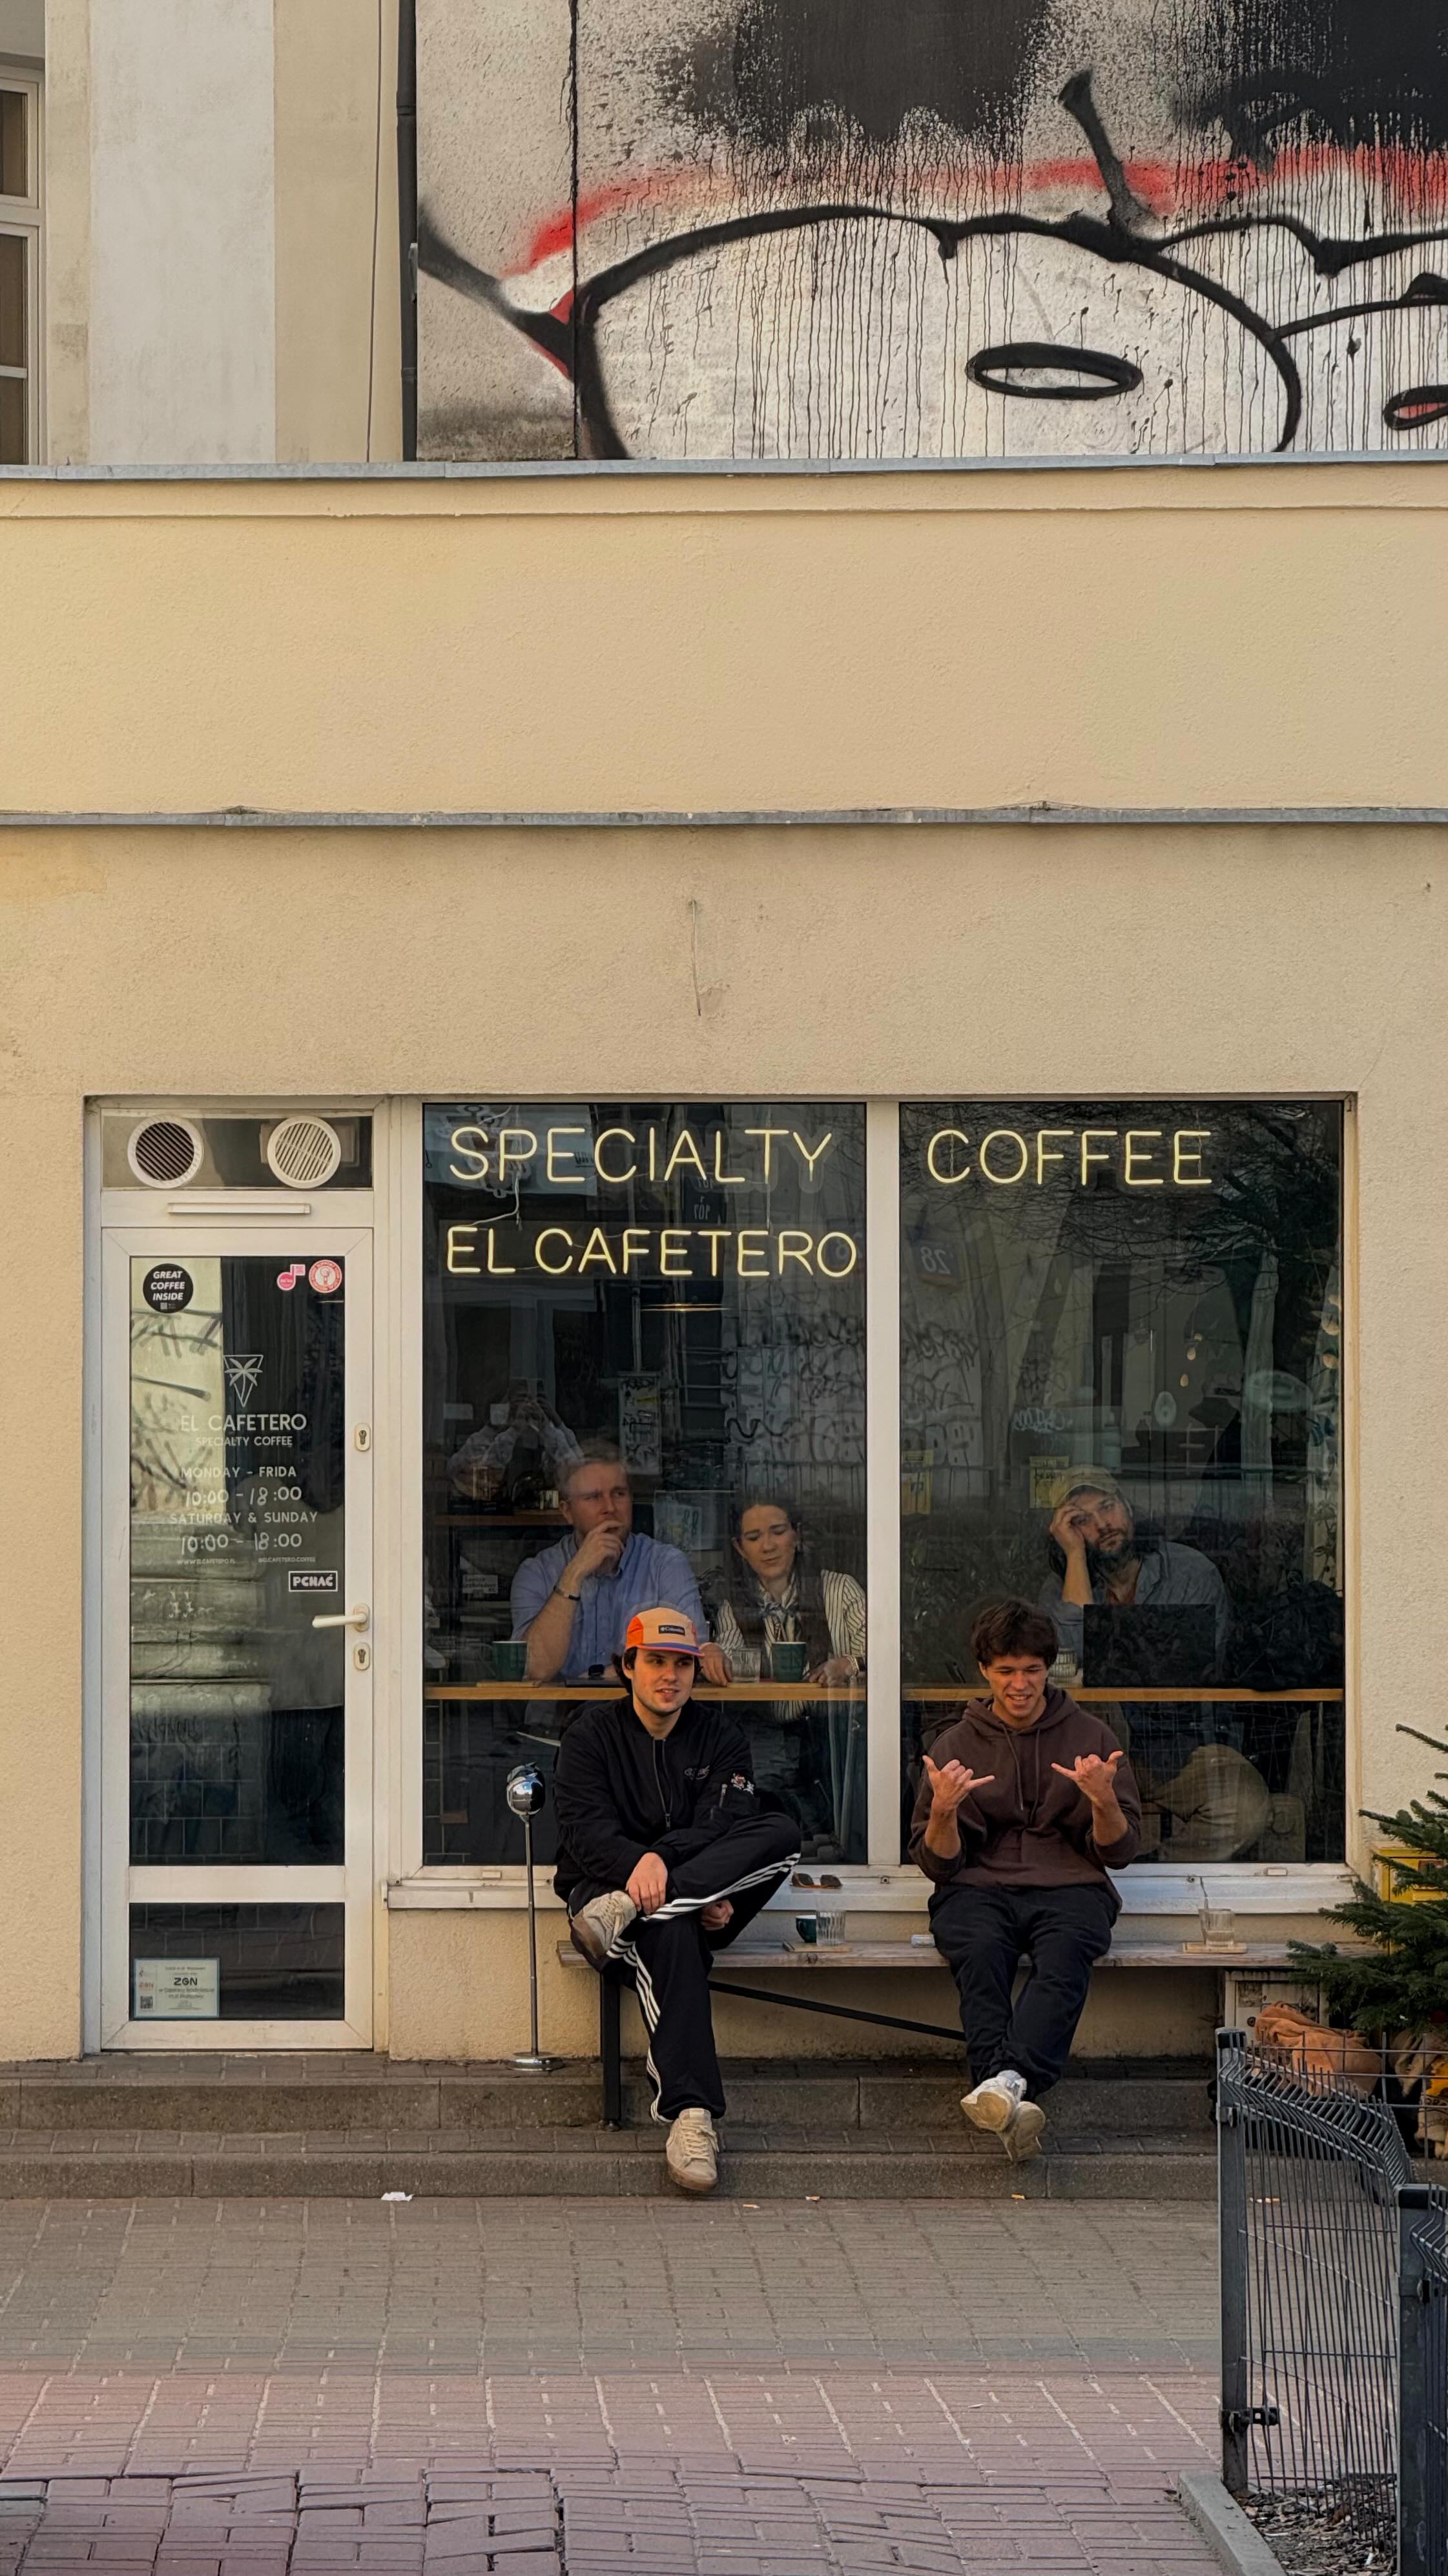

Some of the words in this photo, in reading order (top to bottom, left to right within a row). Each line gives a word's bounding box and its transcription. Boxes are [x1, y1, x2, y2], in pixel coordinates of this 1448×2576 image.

[450, 1127, 832, 1183] SPECIALTY
[927, 1129, 1212, 1185] COFFEE
[447, 1227, 516, 1273] EL
[535, 1228, 857, 1277] CAFETERO
[153, 1271, 183, 1279] GREAT
[150, 1282, 185, 1290] COFFEE
[152, 1293, 183, 1301] INSIDE
[180, 1415, 198, 1432] EL
[209, 1413, 307, 1432] CAFETERO
[196, 1436, 249, 1447] SPECIALTY
[254, 1436, 293, 1446] COFFEE
[181, 1467, 240, 1479] MONDAY
[259, 1466, 296, 1478] FRIDA
[186, 1490, 229, 1507] 10:00
[170, 1511, 241, 1524] SATURDAY
[248, 1511, 256, 1523] &
[264, 1511, 318, 1523] SUNDAY
[181, 1534, 229, 1555] 10:00
[174, 1977, 198, 1986] ZGN
